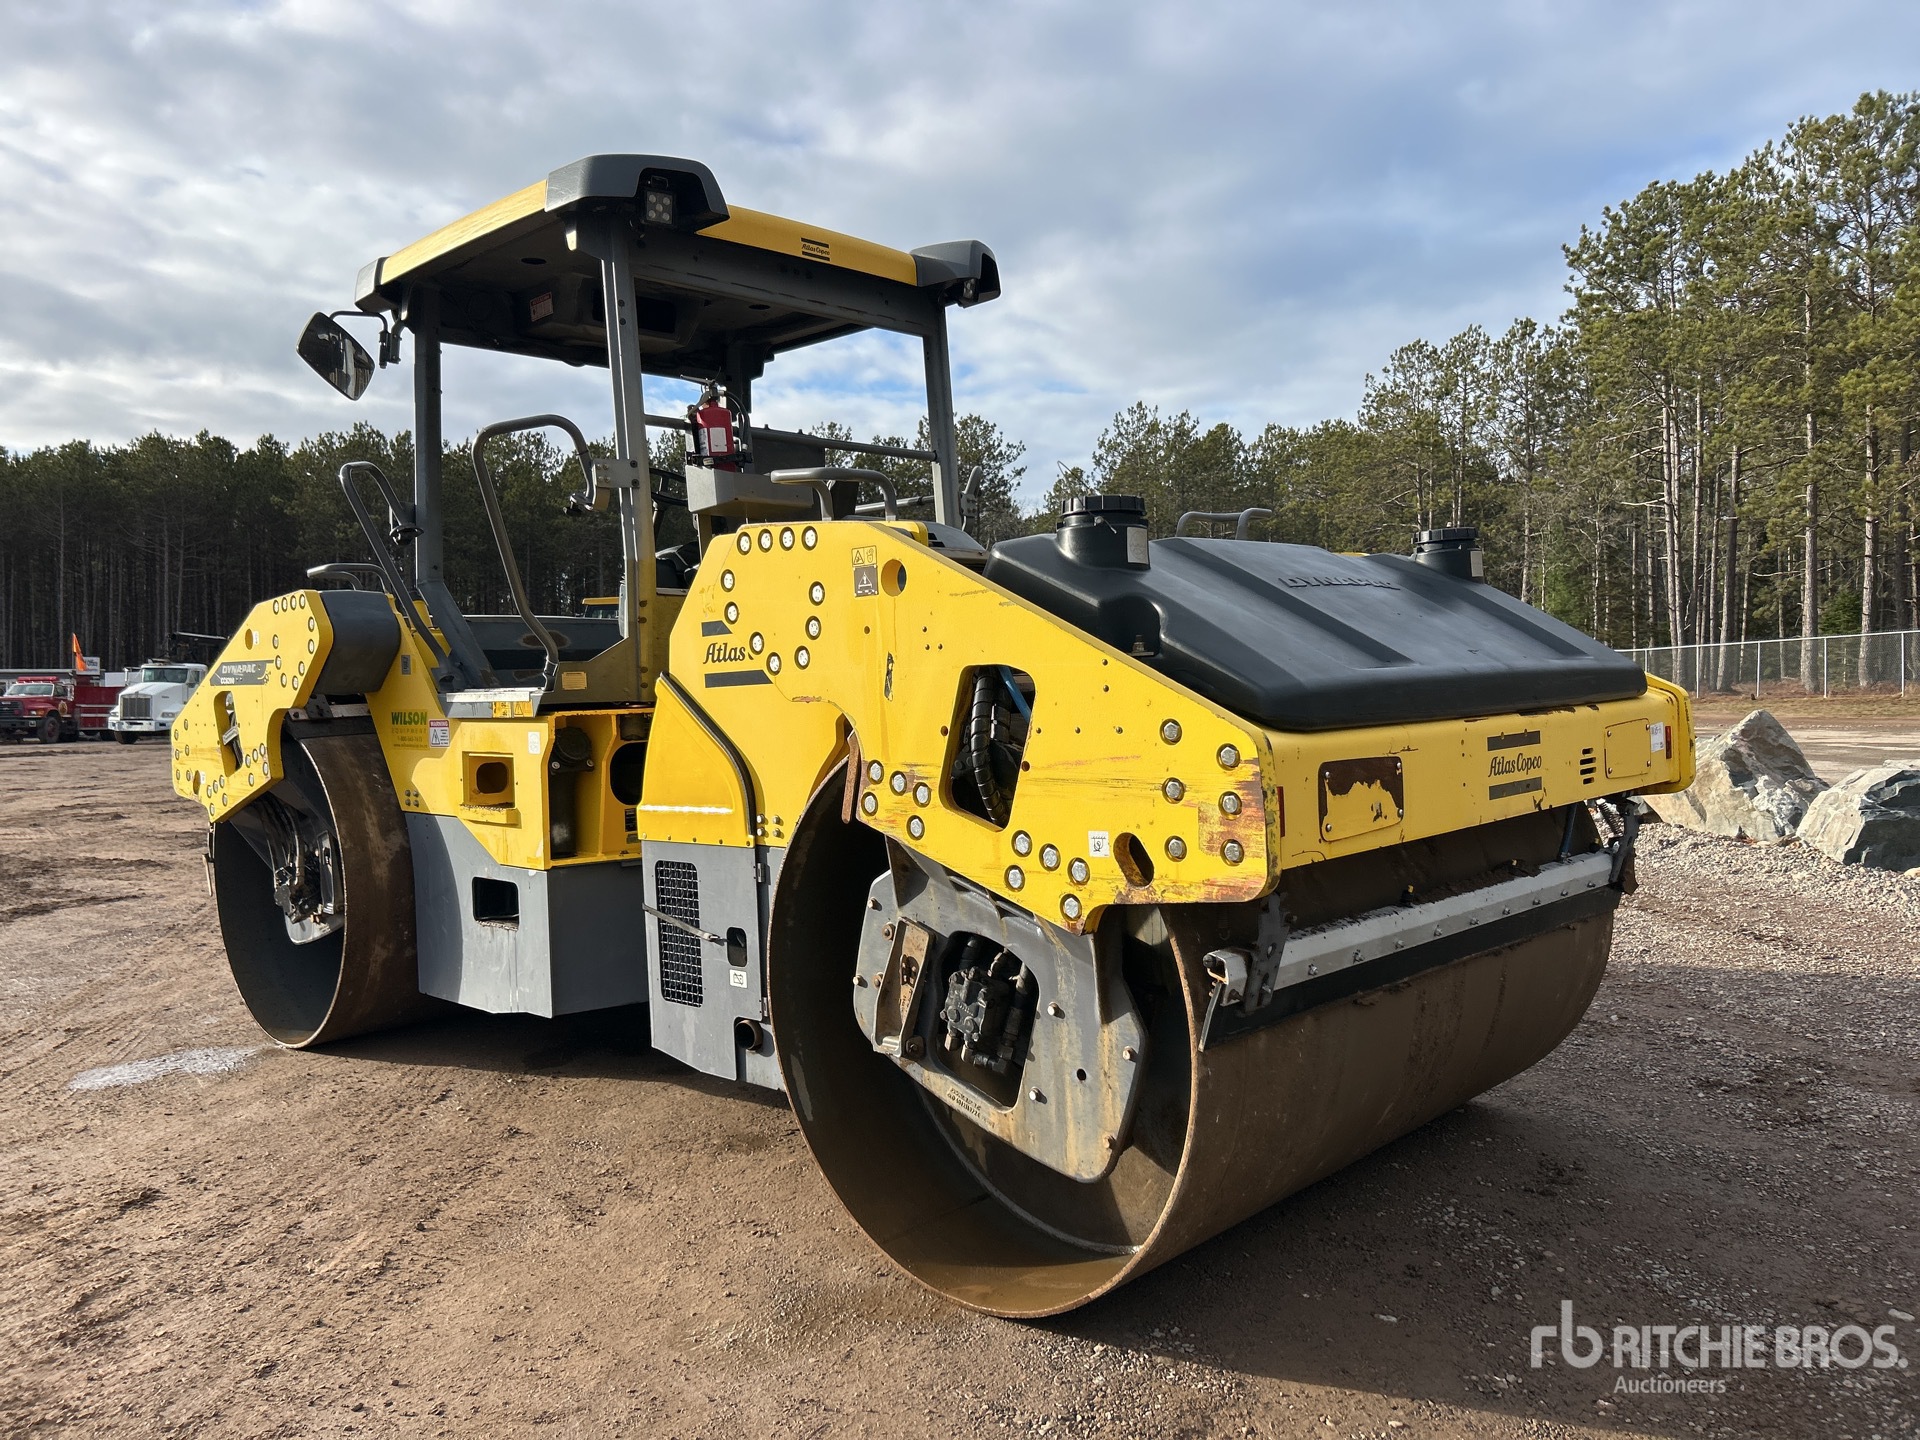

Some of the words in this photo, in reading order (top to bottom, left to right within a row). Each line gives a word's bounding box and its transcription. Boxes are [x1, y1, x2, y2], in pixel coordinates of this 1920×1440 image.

[702, 642, 746, 665] Atlas
[222, 663, 257, 674] DYNAPAC
[391, 711, 428, 725] WILSON
[1488, 756, 1516, 777] Atlas
[1516, 753, 1542, 775] Copco
